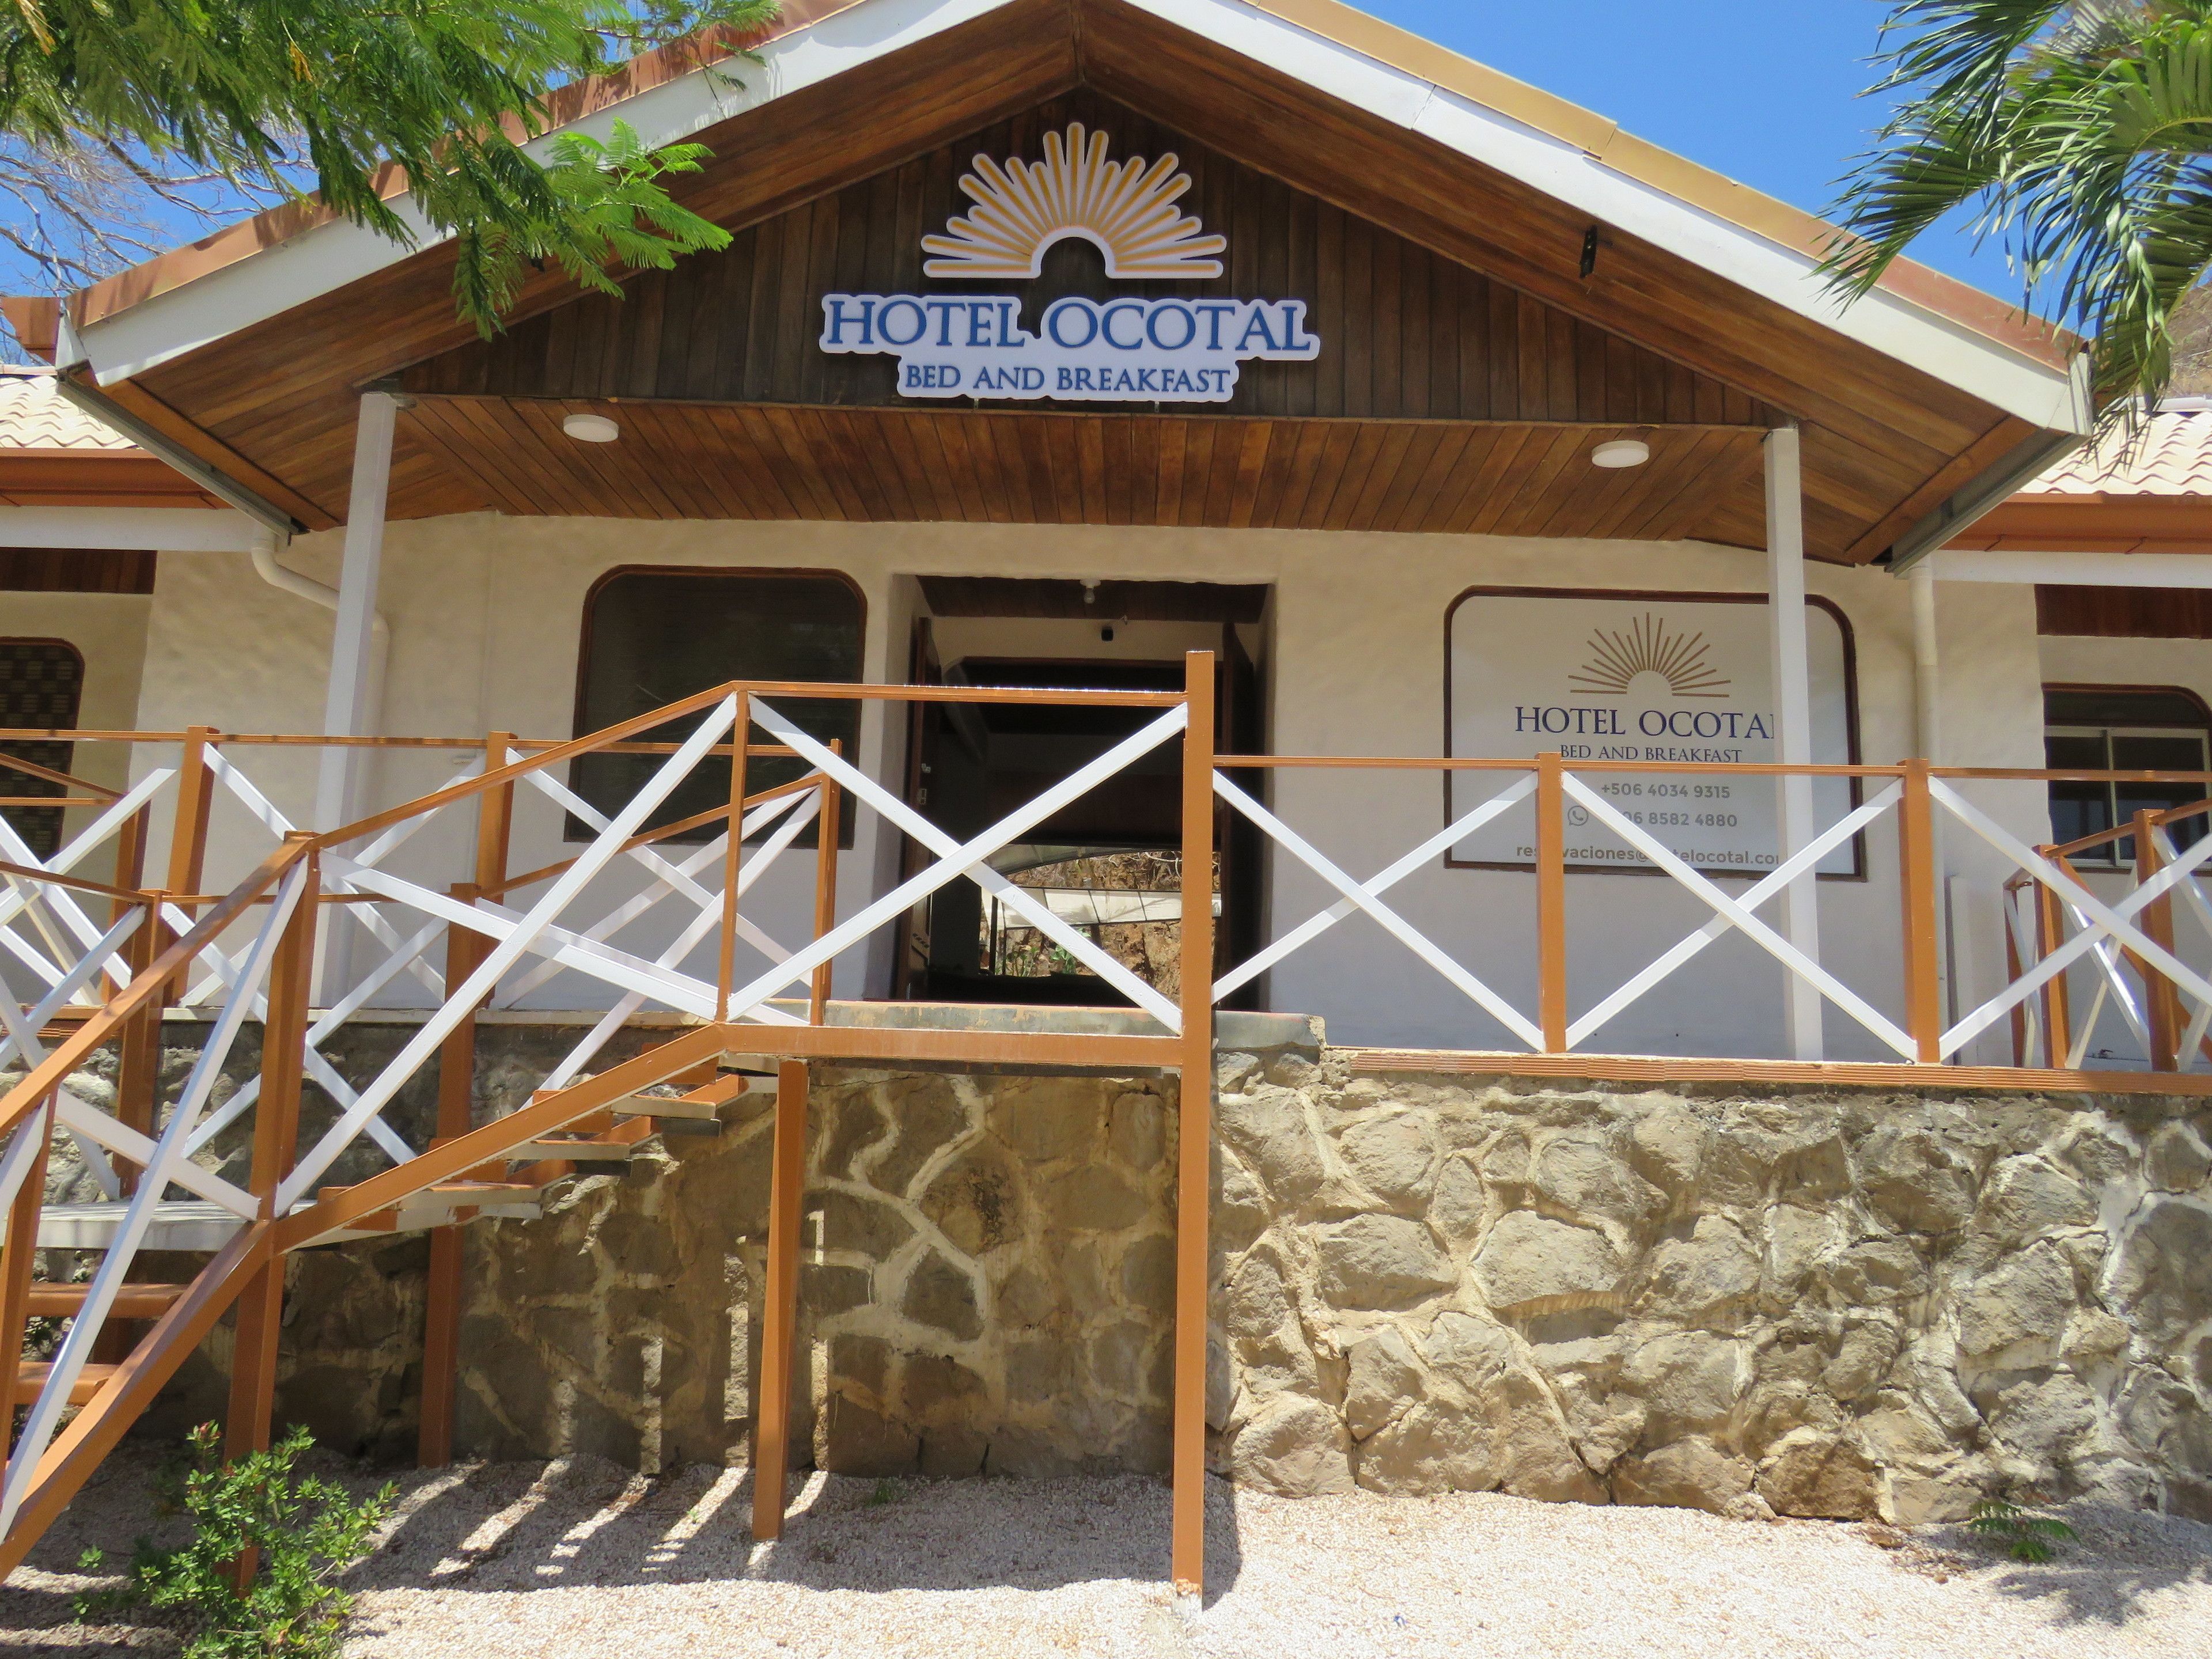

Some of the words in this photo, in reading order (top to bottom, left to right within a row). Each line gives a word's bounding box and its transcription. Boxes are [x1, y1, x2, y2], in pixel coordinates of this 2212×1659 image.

[827, 300, 1025, 347] HOTEL
[1048, 302, 1311, 351] OCOTAL
[906, 365, 961, 389] BED
[972, 366, 1045, 391] AND
[1056, 367, 1231, 393] BREAKFAST
[1514, 706, 1626, 735] HOTEL
[1560, 744, 1592, 759] BED
[1598, 745, 1639, 760] AND
[1645, 747, 1743, 763] BREAKFAST
[1601, 783, 1642, 796] +506
[1647, 784, 1688, 798] 4034
[1694, 785, 1730, 798] 9315
[1649, 812, 1690, 826] 8582
[1695, 813, 1737, 827] 4880
